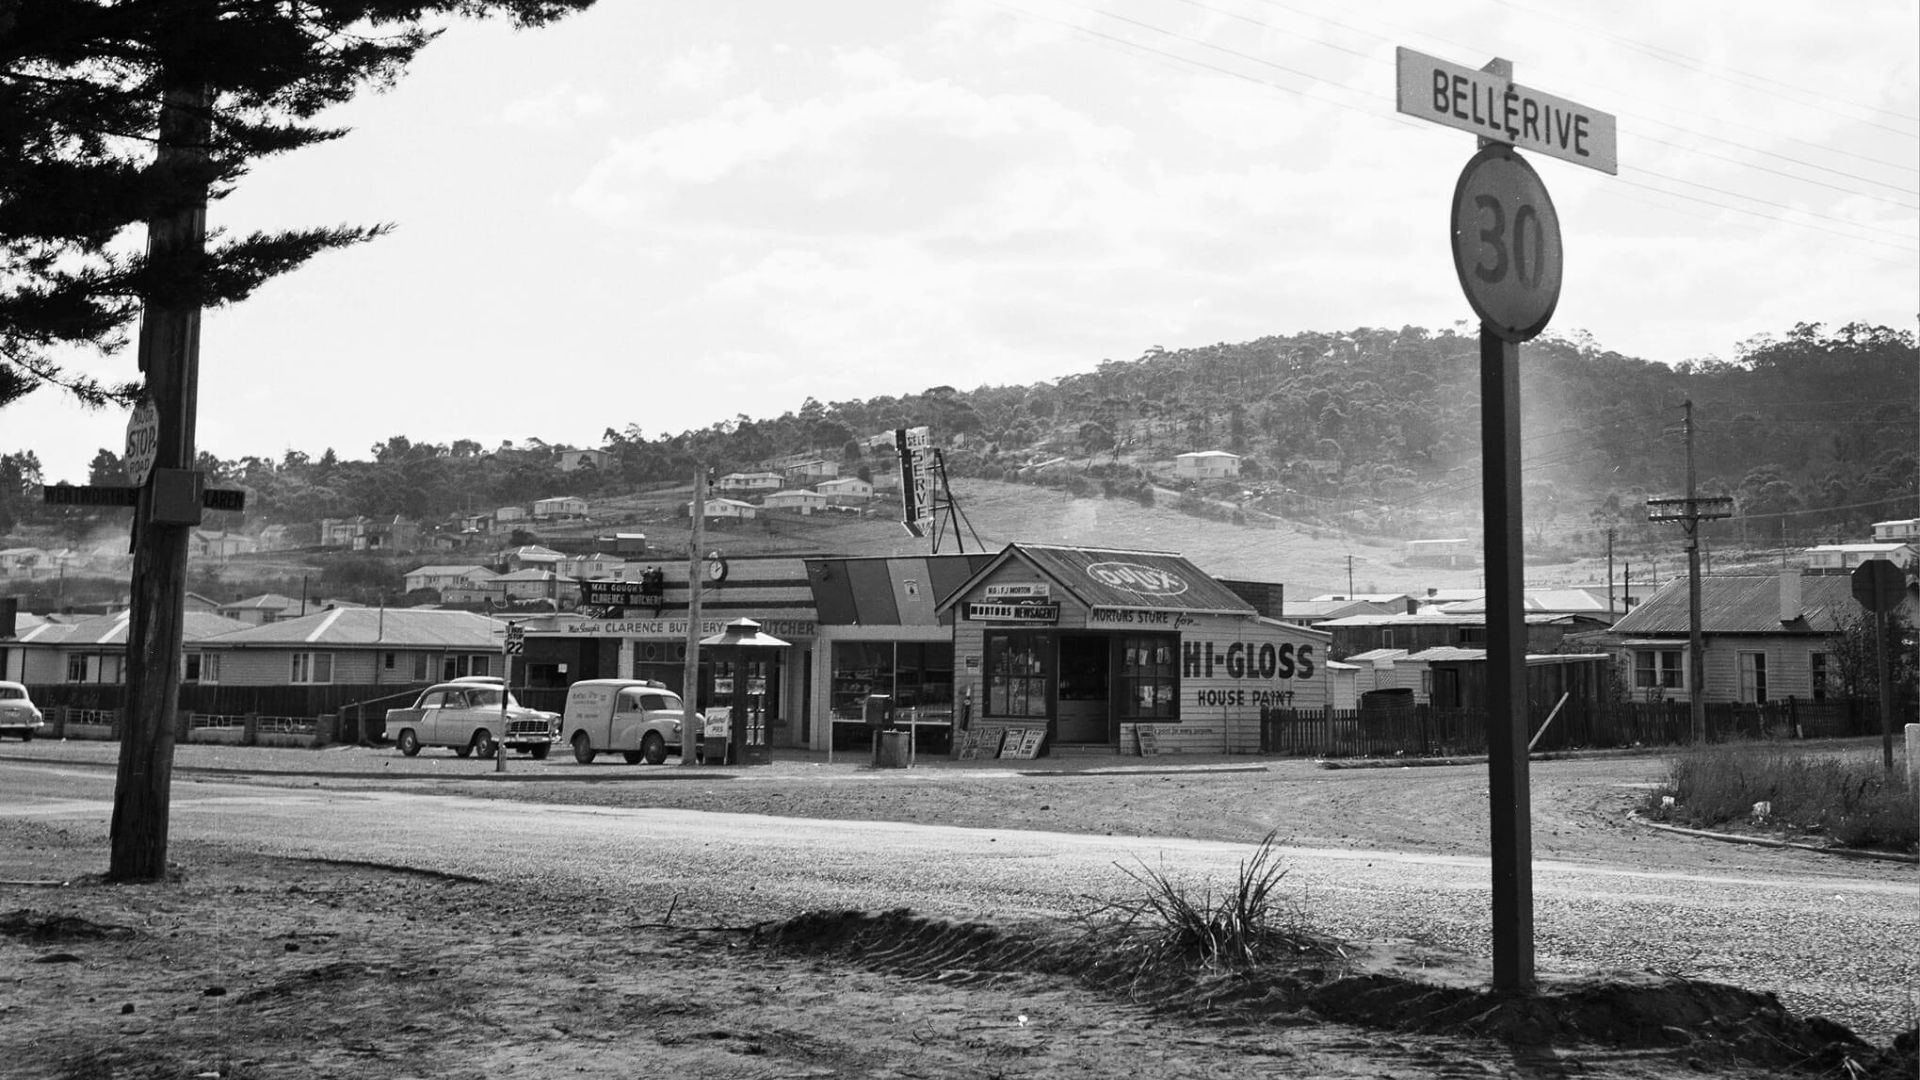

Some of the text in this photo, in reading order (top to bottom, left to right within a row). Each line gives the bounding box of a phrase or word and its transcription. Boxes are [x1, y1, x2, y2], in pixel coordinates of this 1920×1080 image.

[1433, 69, 1589, 157] BELLERIVE
[1474, 194, 1544, 290] 30
[127, 426, 155, 459] STOP
[129, 458, 150, 475] ROAD
[911, 450, 928, 520] SERVE
[44, 488, 123, 504] WENTWORTH
[1096, 566, 1179, 590] DULUX
[1015, 607, 1057, 619] NEWSAGENT
[1138, 610, 1168, 624] STORE
[605, 622, 663, 633] CLARENCE
[668, 623, 724, 633] BUTERY
[507, 641, 522, 655] 22
[1183, 642, 1315, 679] HI-GLOSS
[1198, 690, 1295, 707] HOUSE PAINT
